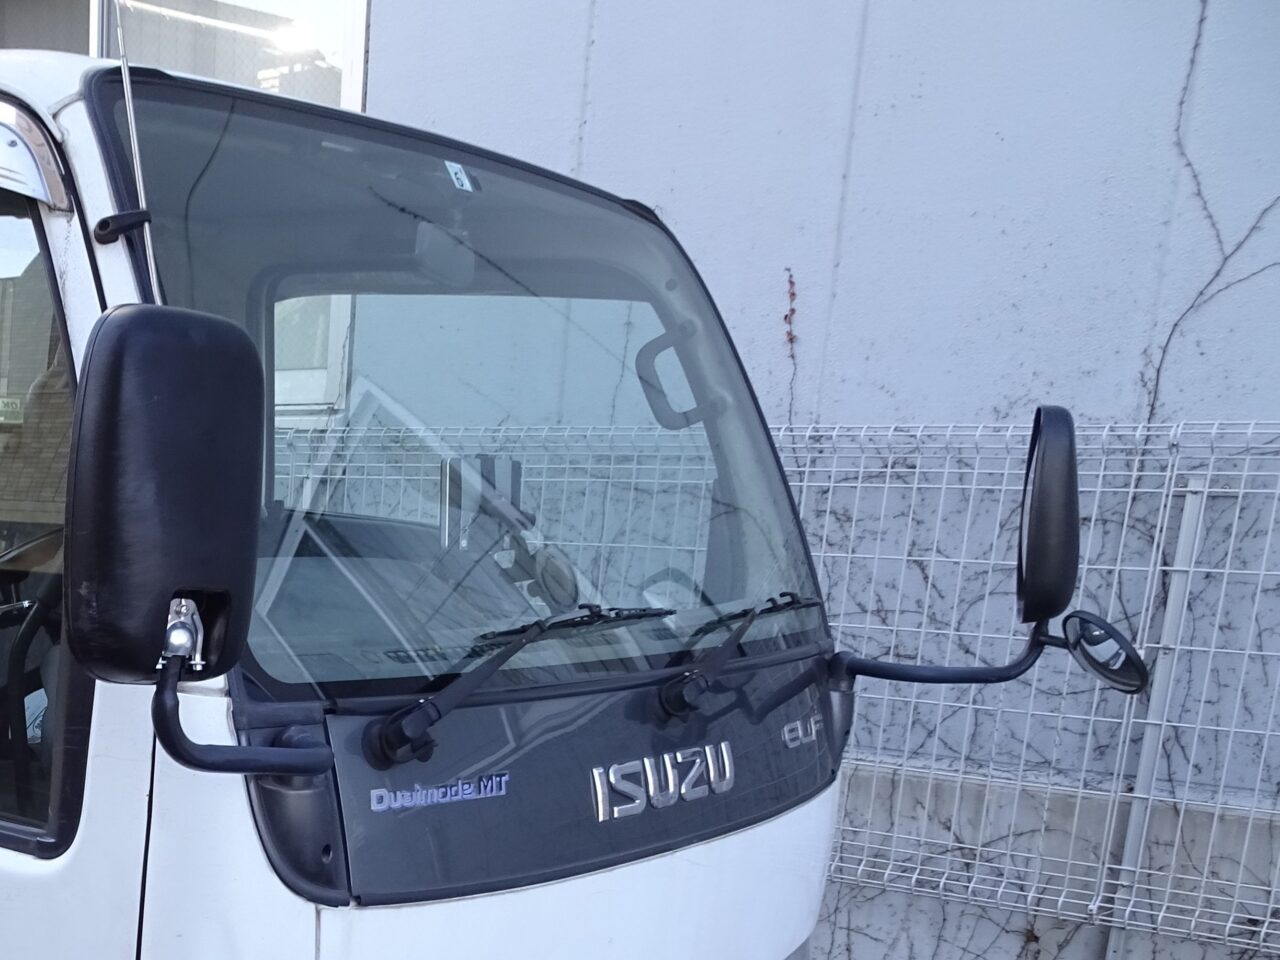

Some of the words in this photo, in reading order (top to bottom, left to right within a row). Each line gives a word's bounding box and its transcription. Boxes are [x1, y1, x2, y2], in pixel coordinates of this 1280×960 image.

[370, 779, 475, 812] Dualmode
[478, 771, 510, 798] MT
[590, 741, 735, 823] ISUZU
